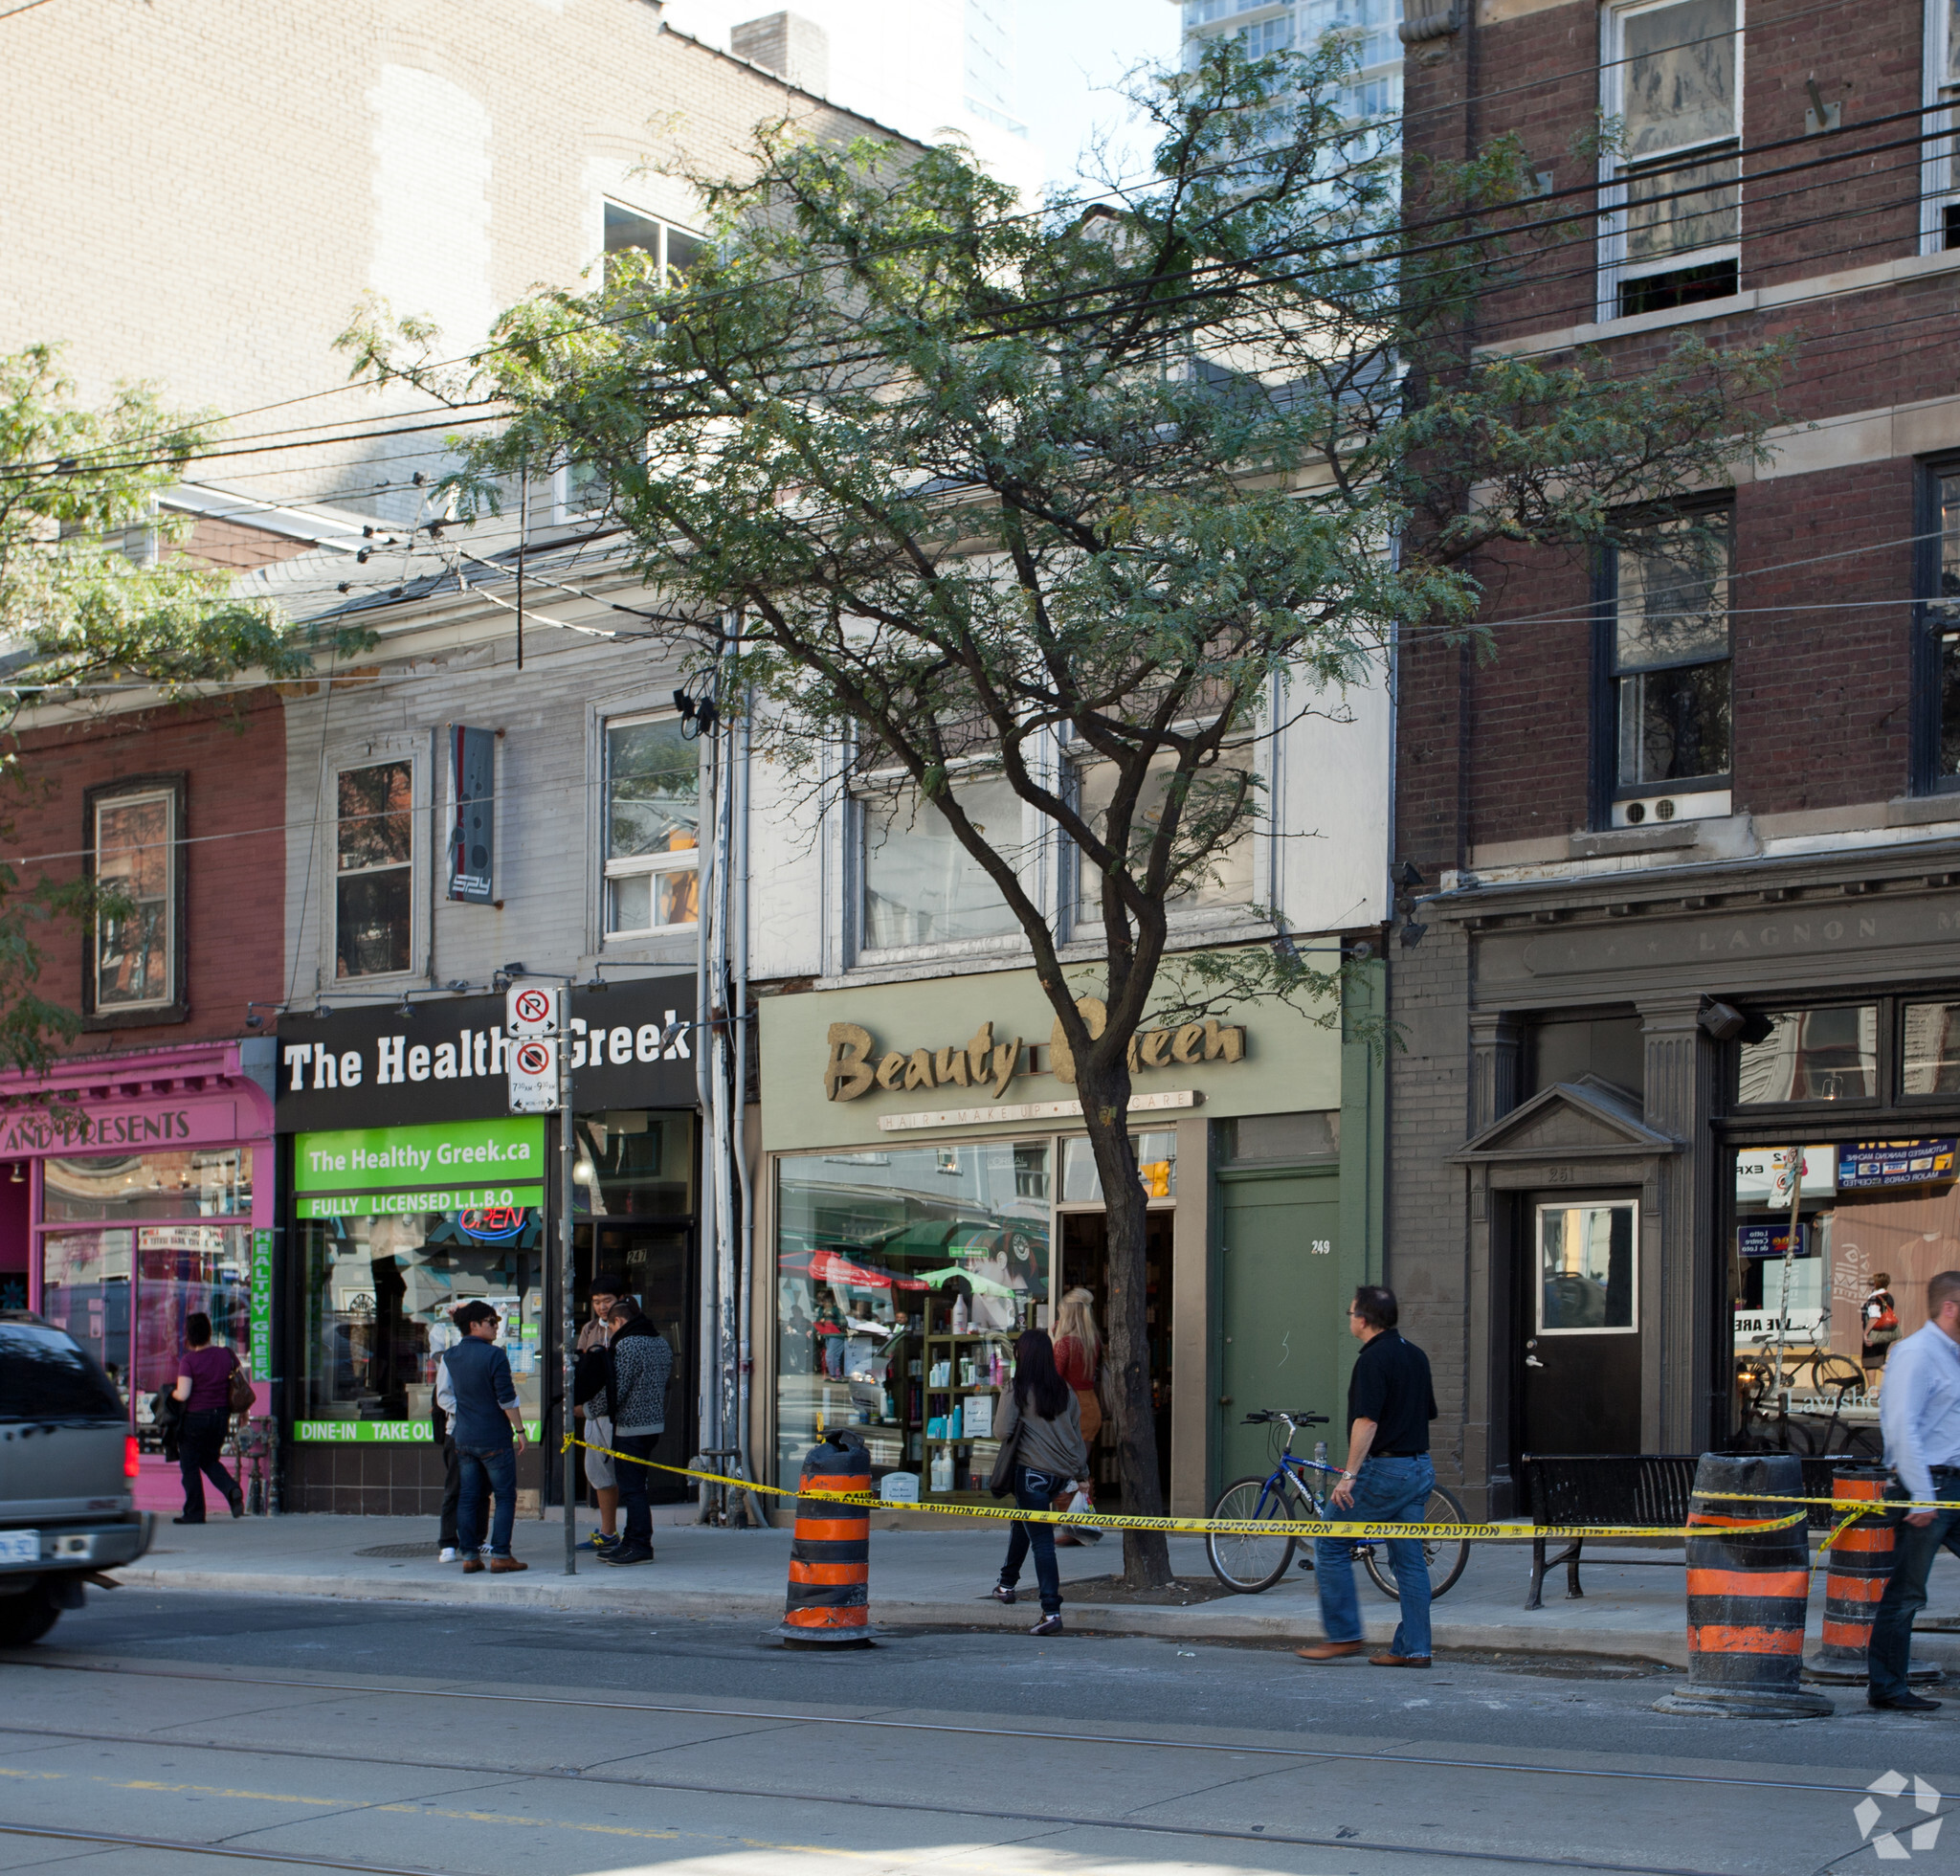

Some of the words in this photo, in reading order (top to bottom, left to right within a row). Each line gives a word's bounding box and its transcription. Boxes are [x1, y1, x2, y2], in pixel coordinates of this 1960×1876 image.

[1699, 919, 1877, 952] LAGNON
[284, 1043, 362, 1091] The
[377, 1026, 511, 1085] Health
[824, 1020, 1023, 1102] Beauty
[886, 1115, 930, 1129] HAIR
[957, 1107, 1008, 1124] MAKE
[1021, 1105, 1042, 1119] UP
[1131, 1093, 1185, 1110] CARE
[5, 1124, 53, 1151] AND
[63, 1110, 190, 1148] PRESENTS
[310, 1151, 345, 1172] The
[351, 1145, 432, 1172] Healthy
[436, 1139, 530, 1165] Greek.ca
[312, 1197, 359, 1217] FULLY
[371, 1193, 452, 1214] LICENSED
[460, 1206, 524, 1230] OPEN
[1311, 1240, 1331, 1255] 249
[253, 1231, 271, 1316] HEALTHY
[252, 1320, 269, 1381] GREEK
[301, 1422, 357, 1440] DINE-IN
[372, 1422, 411, 1440] TAKE
[412, 1422, 434, 1440] OU
[976, 1508, 1033, 1521] CAUTION
[1058, 1513, 1117, 1527] CAUTION
[1117, 1517, 1178, 1530] CAUTION
[1205, 1520, 1270, 1533] CAUTION
[1270, 1522, 1333, 1534] CAUTION
[1364, 1524, 1430, 1536] CAUTION
[1432, 1525, 1501, 1537] CAUTION
